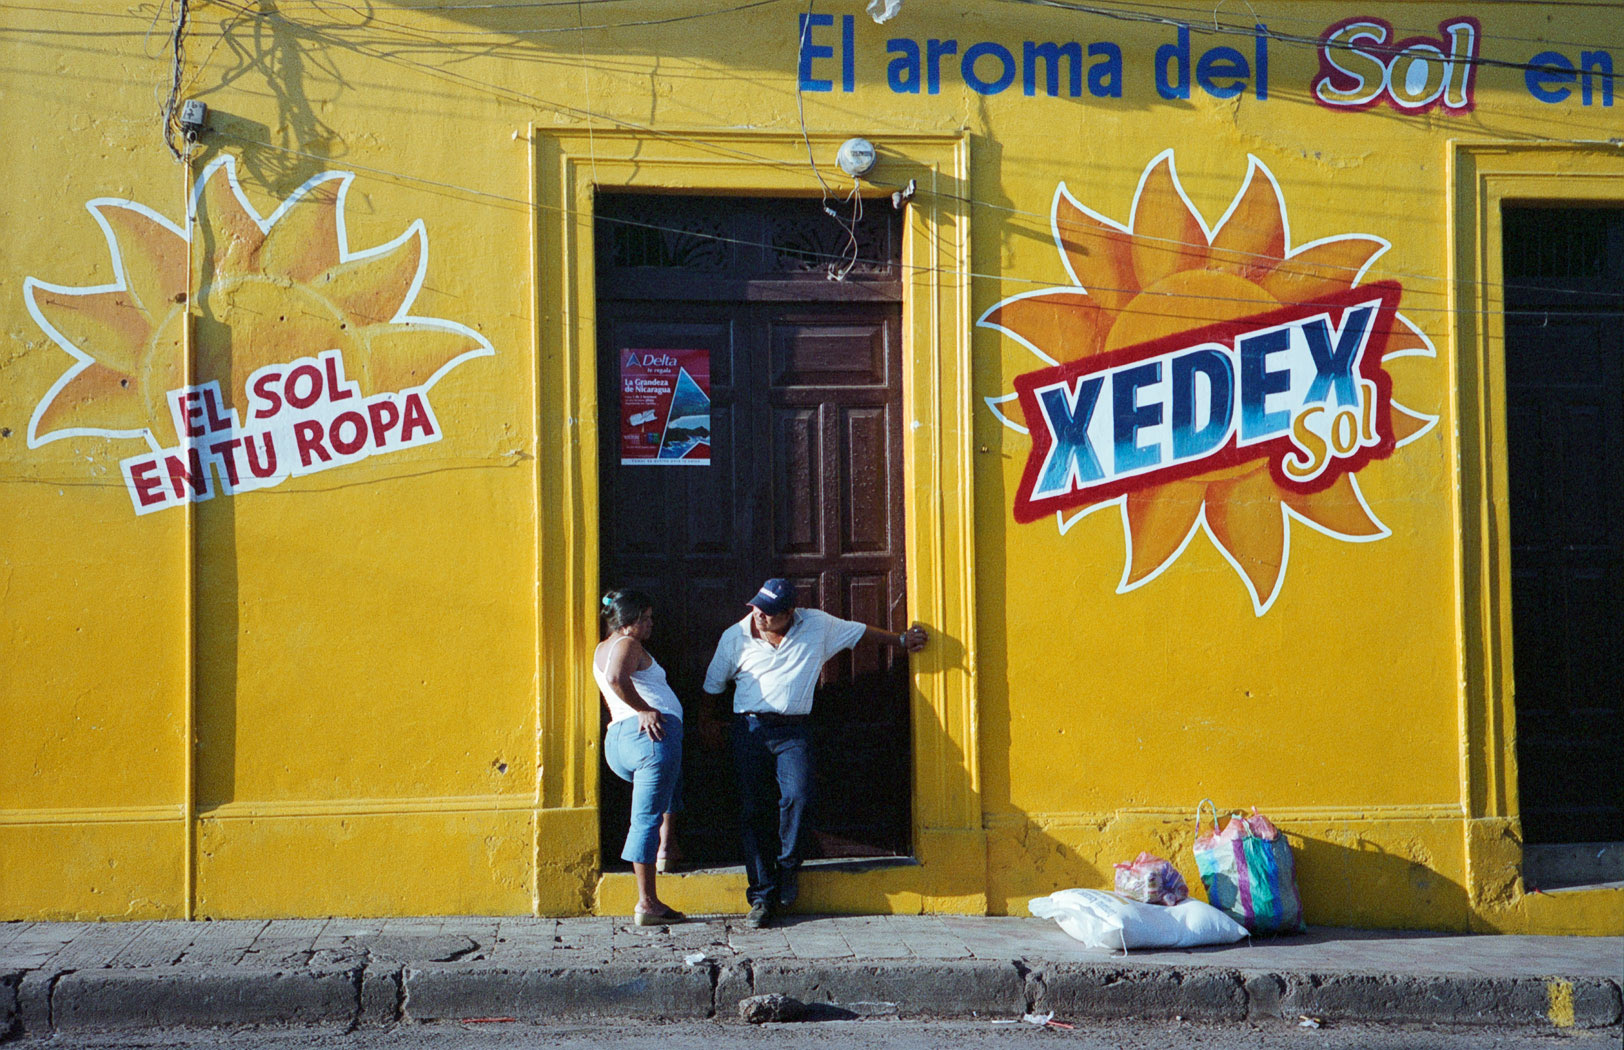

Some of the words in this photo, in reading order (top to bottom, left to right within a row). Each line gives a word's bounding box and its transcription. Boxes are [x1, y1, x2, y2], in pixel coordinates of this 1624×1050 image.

[798, 13, 855, 92] El
[886, 38, 1123, 98] aroma
[1153, 23, 1268, 101] del
[1313, 18, 1478, 112] Sol
[1524, 50, 1614, 107] en
[178, 389, 232, 437] EL
[253, 356, 353, 419] SOL
[635, 378, 669, 386] Grandeza
[635, 386, 671, 395] Nicaragua
[642, 354, 678, 366] Delta
[1031, 300, 1381, 499] XEDEX
[129, 447, 208, 507] EN
[210, 431, 278, 486] TU
[293, 393, 435, 467] ROPA
[1285, 383, 1379, 479] Sol
